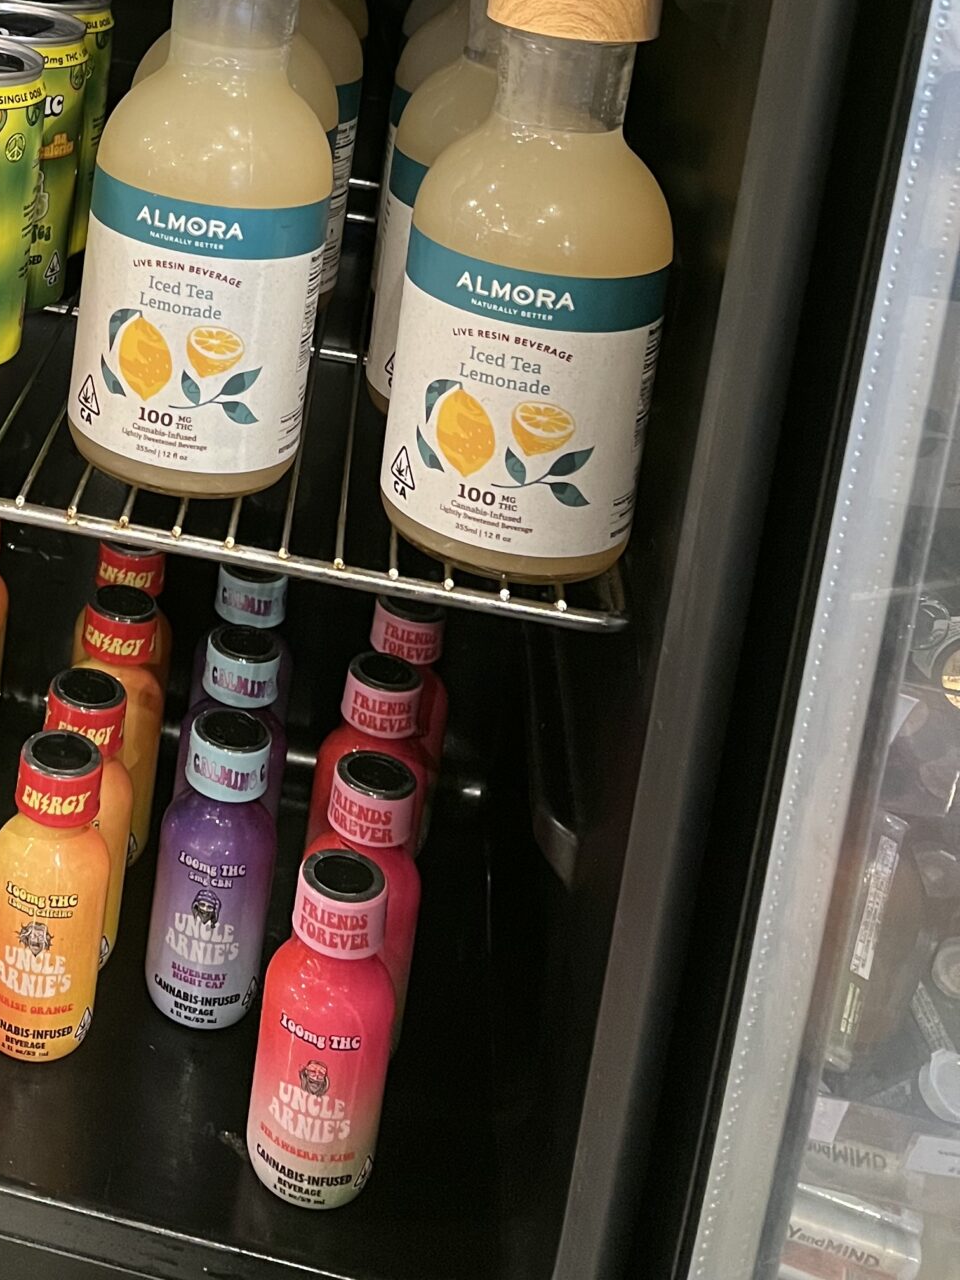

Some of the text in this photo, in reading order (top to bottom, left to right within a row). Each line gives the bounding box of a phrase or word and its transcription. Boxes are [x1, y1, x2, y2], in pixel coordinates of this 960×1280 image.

[136, 205, 244, 240] ALMORA
[150, 231, 224, 250] NATURALLY BETTER
[133, 258, 243, 288] LIVE RESIN BEVERAGE
[148, 275, 214, 301] Iced Tea
[139, 292, 222, 320] Lemonade
[456, 271, 575, 312] ALMORA
[471, 298, 553, 321] NATURALLY BETTER
[452, 328, 574, 363] LIVE RESIN BEVERAGE
[470, 345, 542, 375] Iced Tea
[459, 362, 551, 396] Lemonade
[132, 422, 197, 442] Cannabis-Infused
[137, 406, 174, 428] 100
[457, 483, 496, 506] 100
[451, 499, 522, 524] Cannabis-Infused
[221, 864, 246, 877] THC
[49, 894, 78, 908] THC
[303, 896, 368, 931] FRIENDS
[165, 927, 239, 965] ARNIE'S
[300, 914, 369, 950] FOREVER
[281, 1013, 361, 1051] 100mg THC
[268, 1096, 350, 1143] ARNIE'S
